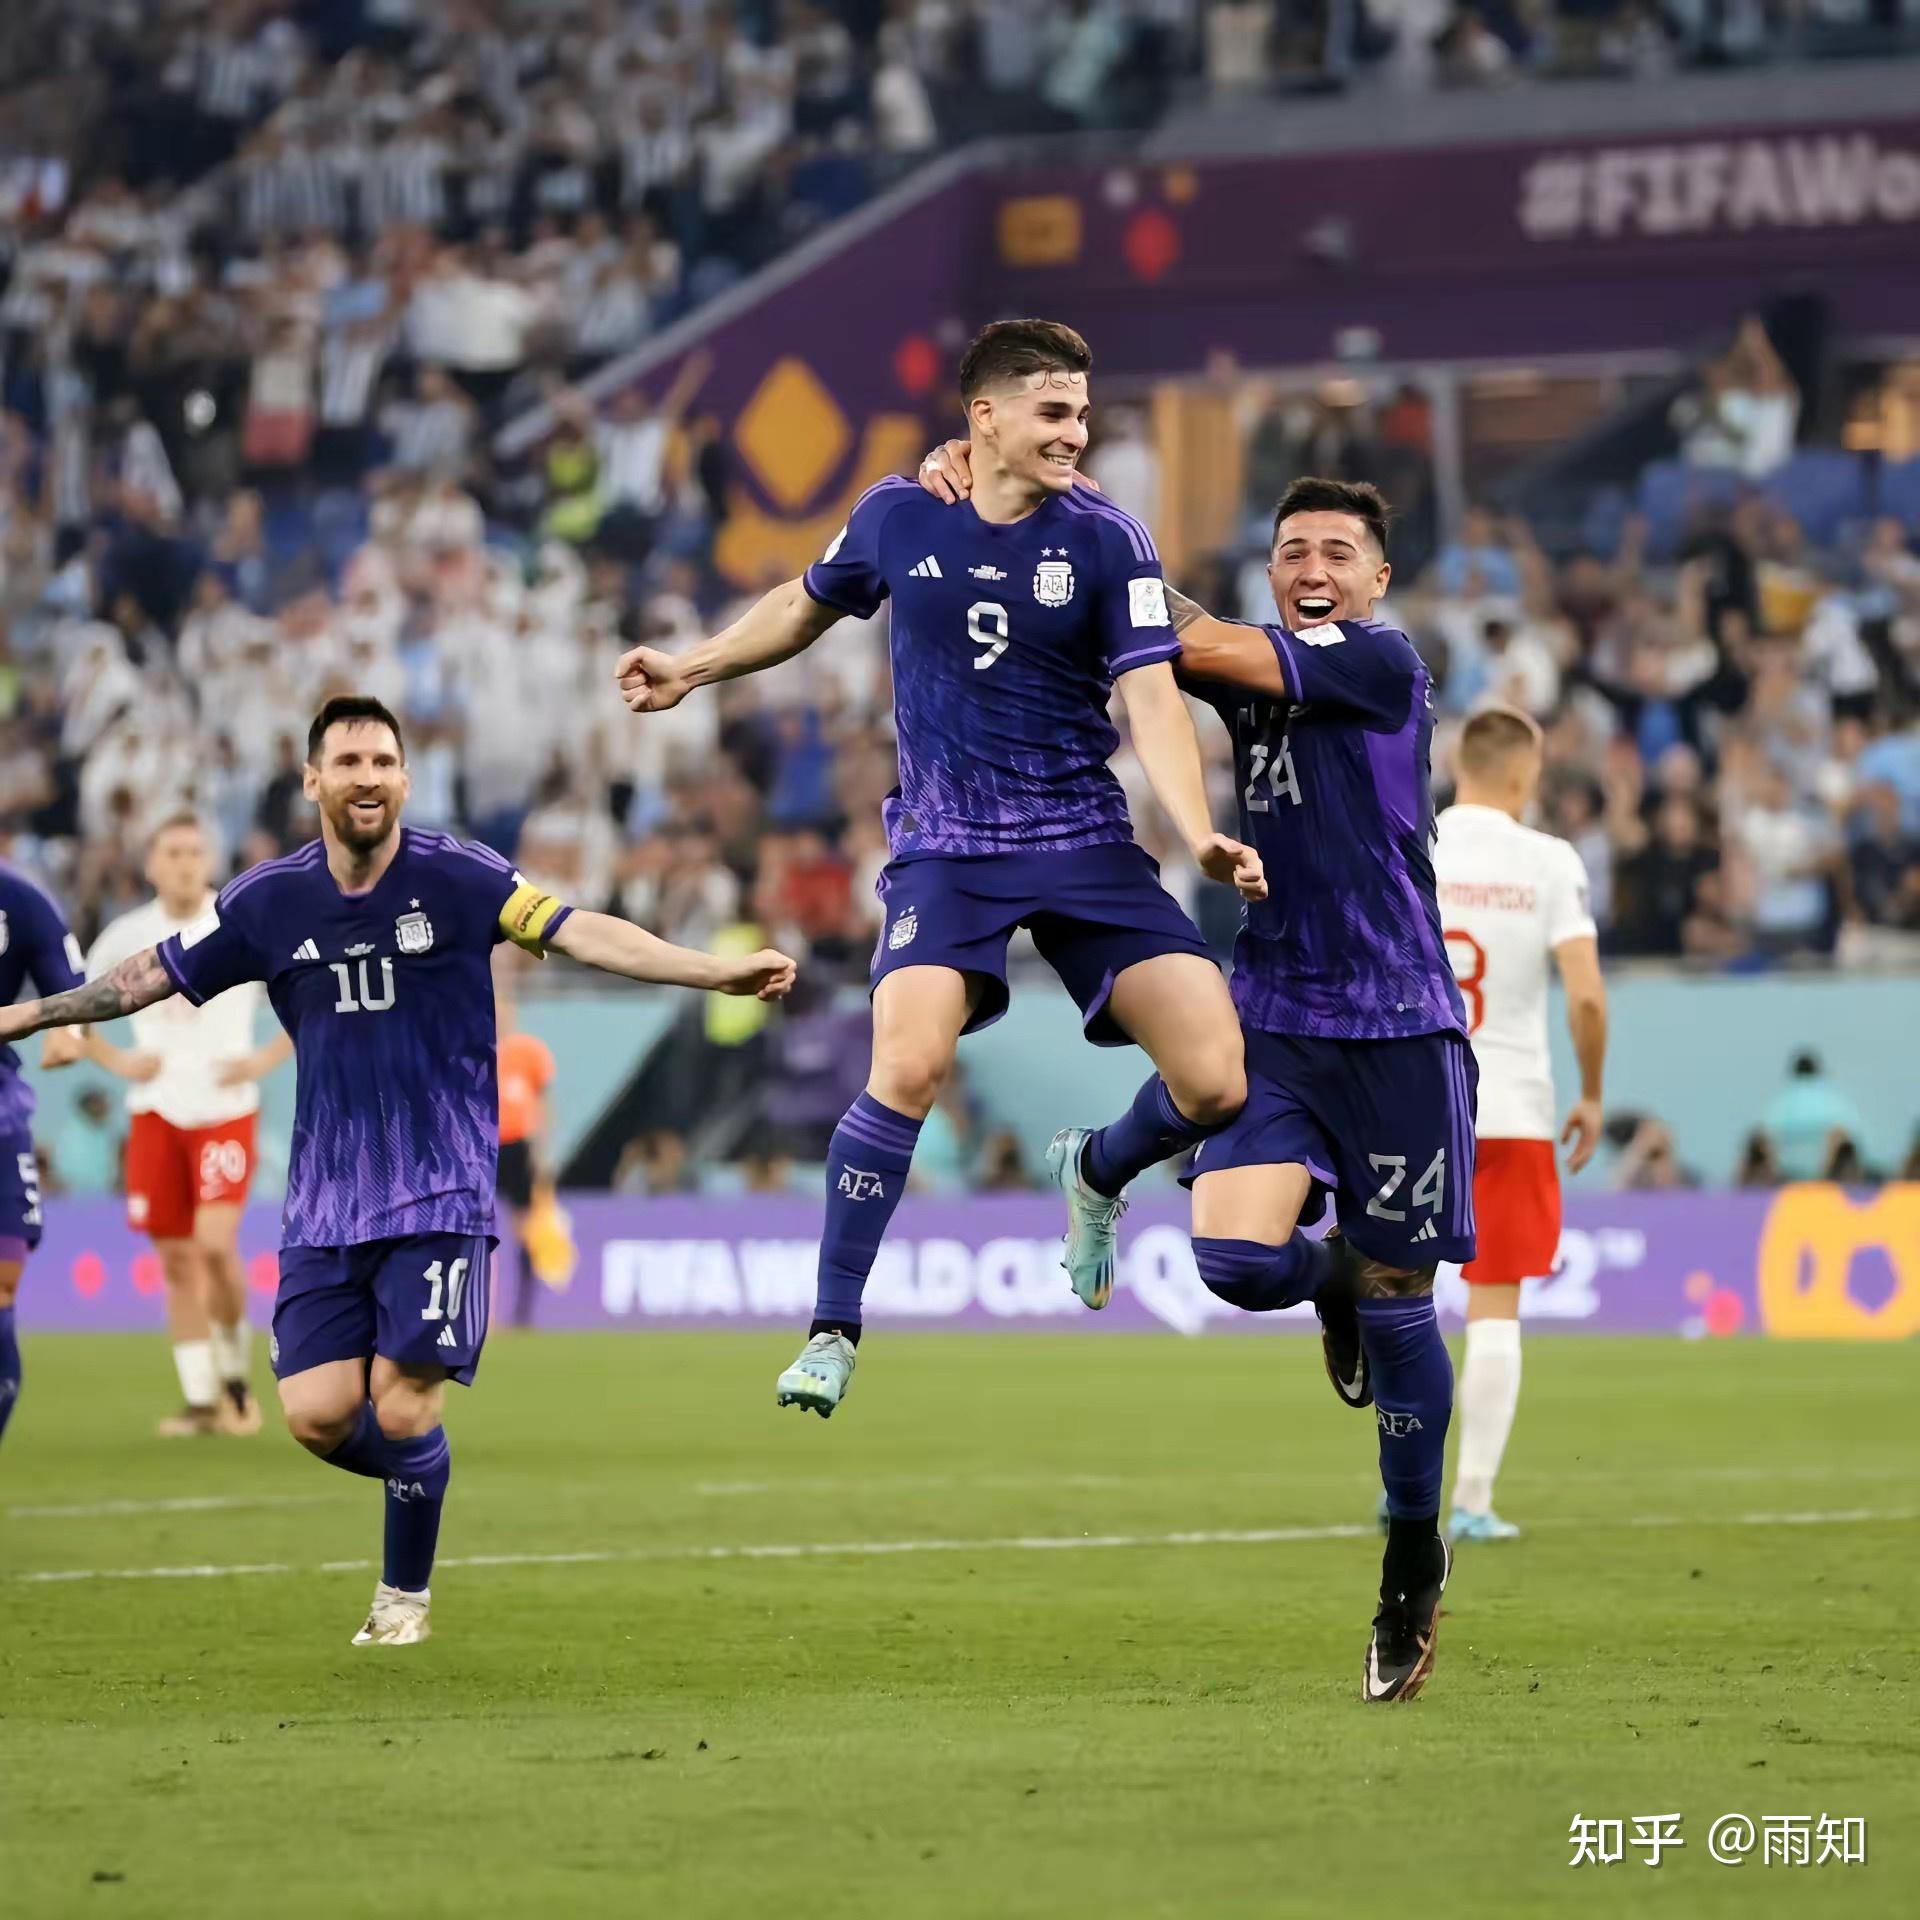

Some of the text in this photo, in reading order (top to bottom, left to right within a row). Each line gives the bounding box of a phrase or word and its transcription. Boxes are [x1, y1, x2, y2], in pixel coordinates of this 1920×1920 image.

[967, 601, 1009, 669] 9
[1244, 734, 1303, 812] 24
[328, 956, 396, 1013] 10
[200, 1139, 247, 1184] 20
[837, 1163, 885, 1201] AFA
[1366, 1147, 1445, 1221] 24
[421, 1257, 469, 1320] 10
[602, 1238, 741, 1316] FIFA
[1376, 1404, 1424, 1438] AFA
